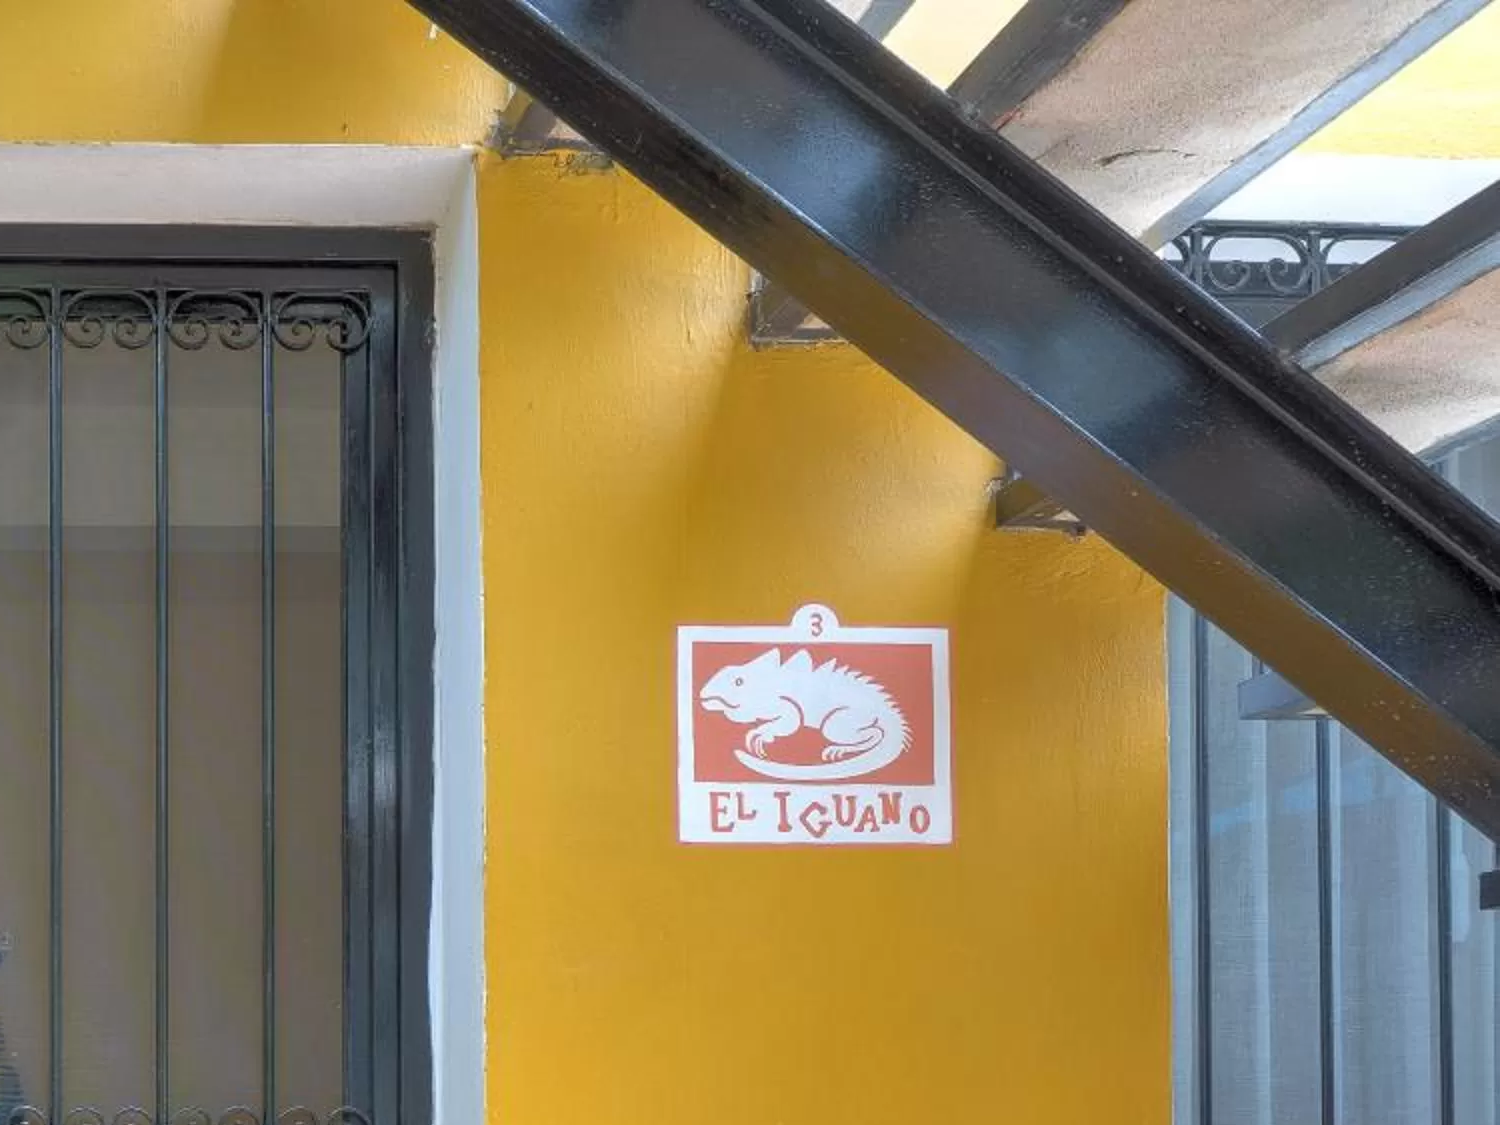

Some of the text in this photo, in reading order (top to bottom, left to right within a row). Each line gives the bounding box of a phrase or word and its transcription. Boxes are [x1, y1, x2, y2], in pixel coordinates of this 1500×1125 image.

[811, 612, 823, 637] 3
[708, 791, 931, 838] EL IGUANO
